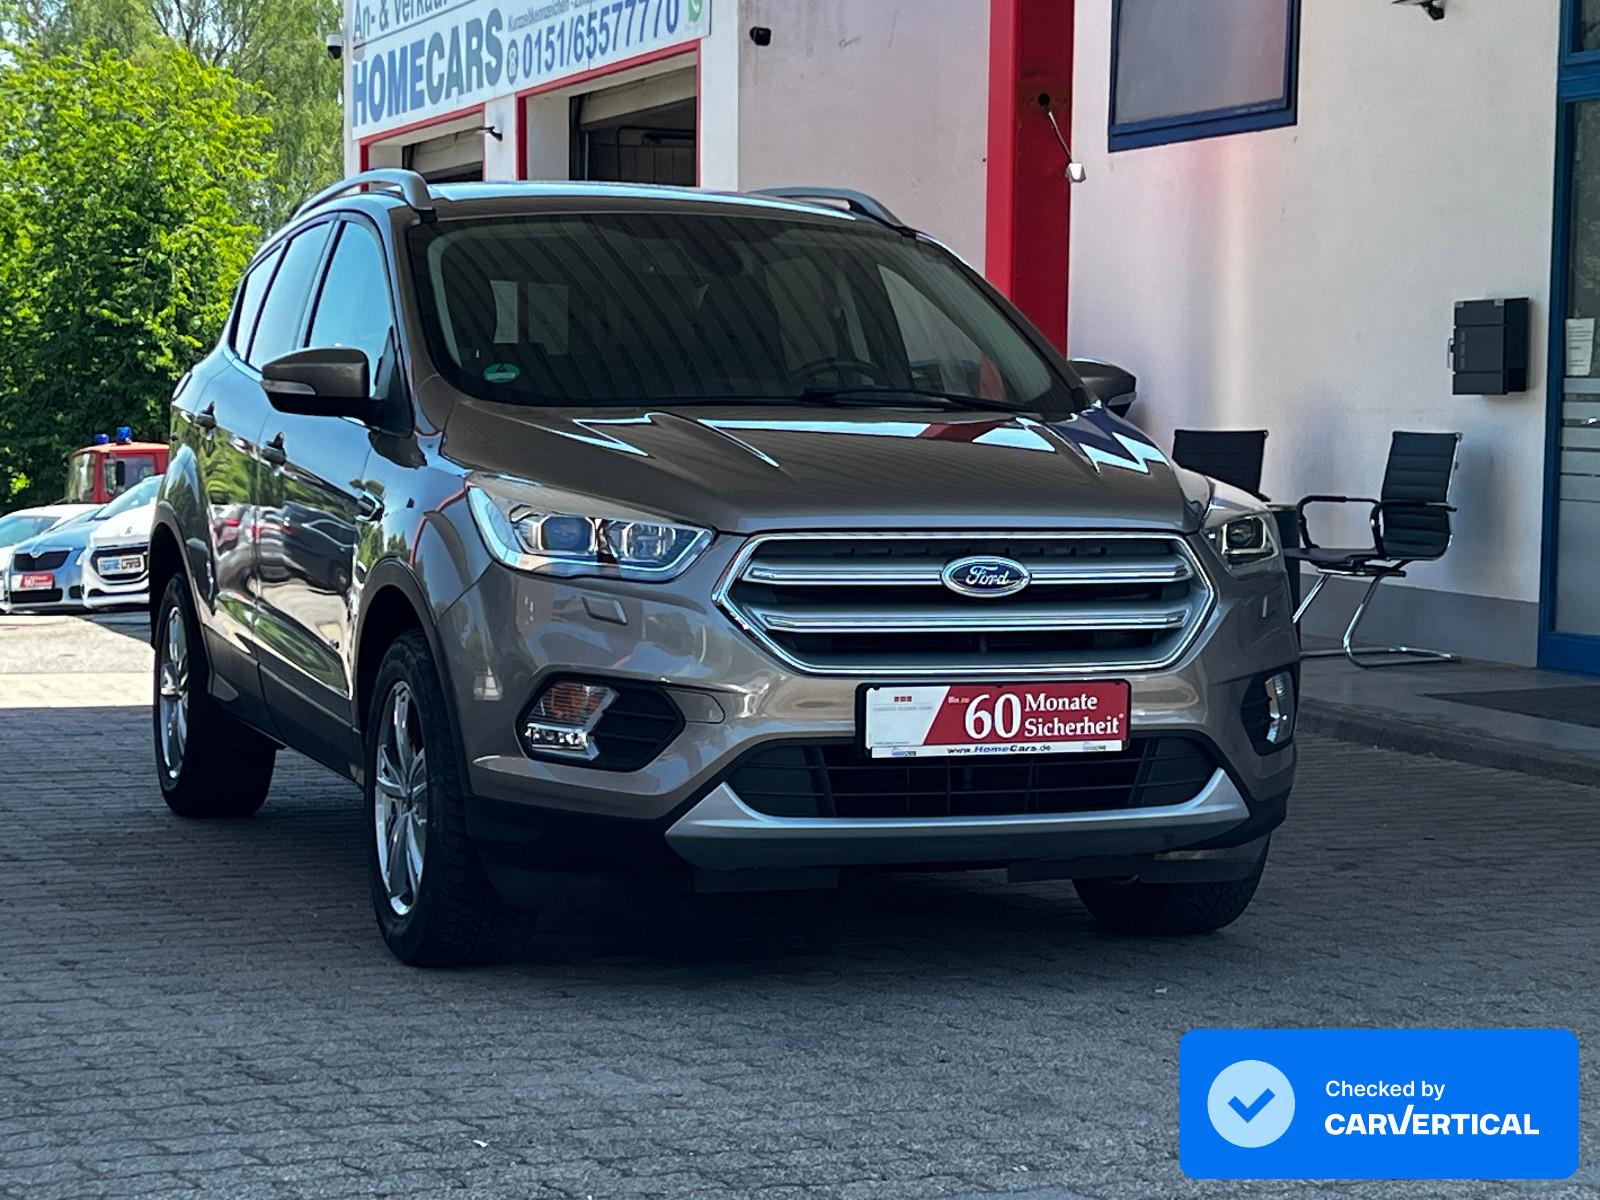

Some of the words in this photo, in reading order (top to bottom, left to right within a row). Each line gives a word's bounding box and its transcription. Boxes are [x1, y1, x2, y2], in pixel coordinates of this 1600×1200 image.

[352, 0, 376, 42] An-
[352, 8, 503, 127] HOMECARS
[965, 565, 1010, 586] Ford
[964, 693, 1022, 740] 60
[1024, 693, 1099, 713] Monate
[1024, 715, 1120, 738] Sicherheit
